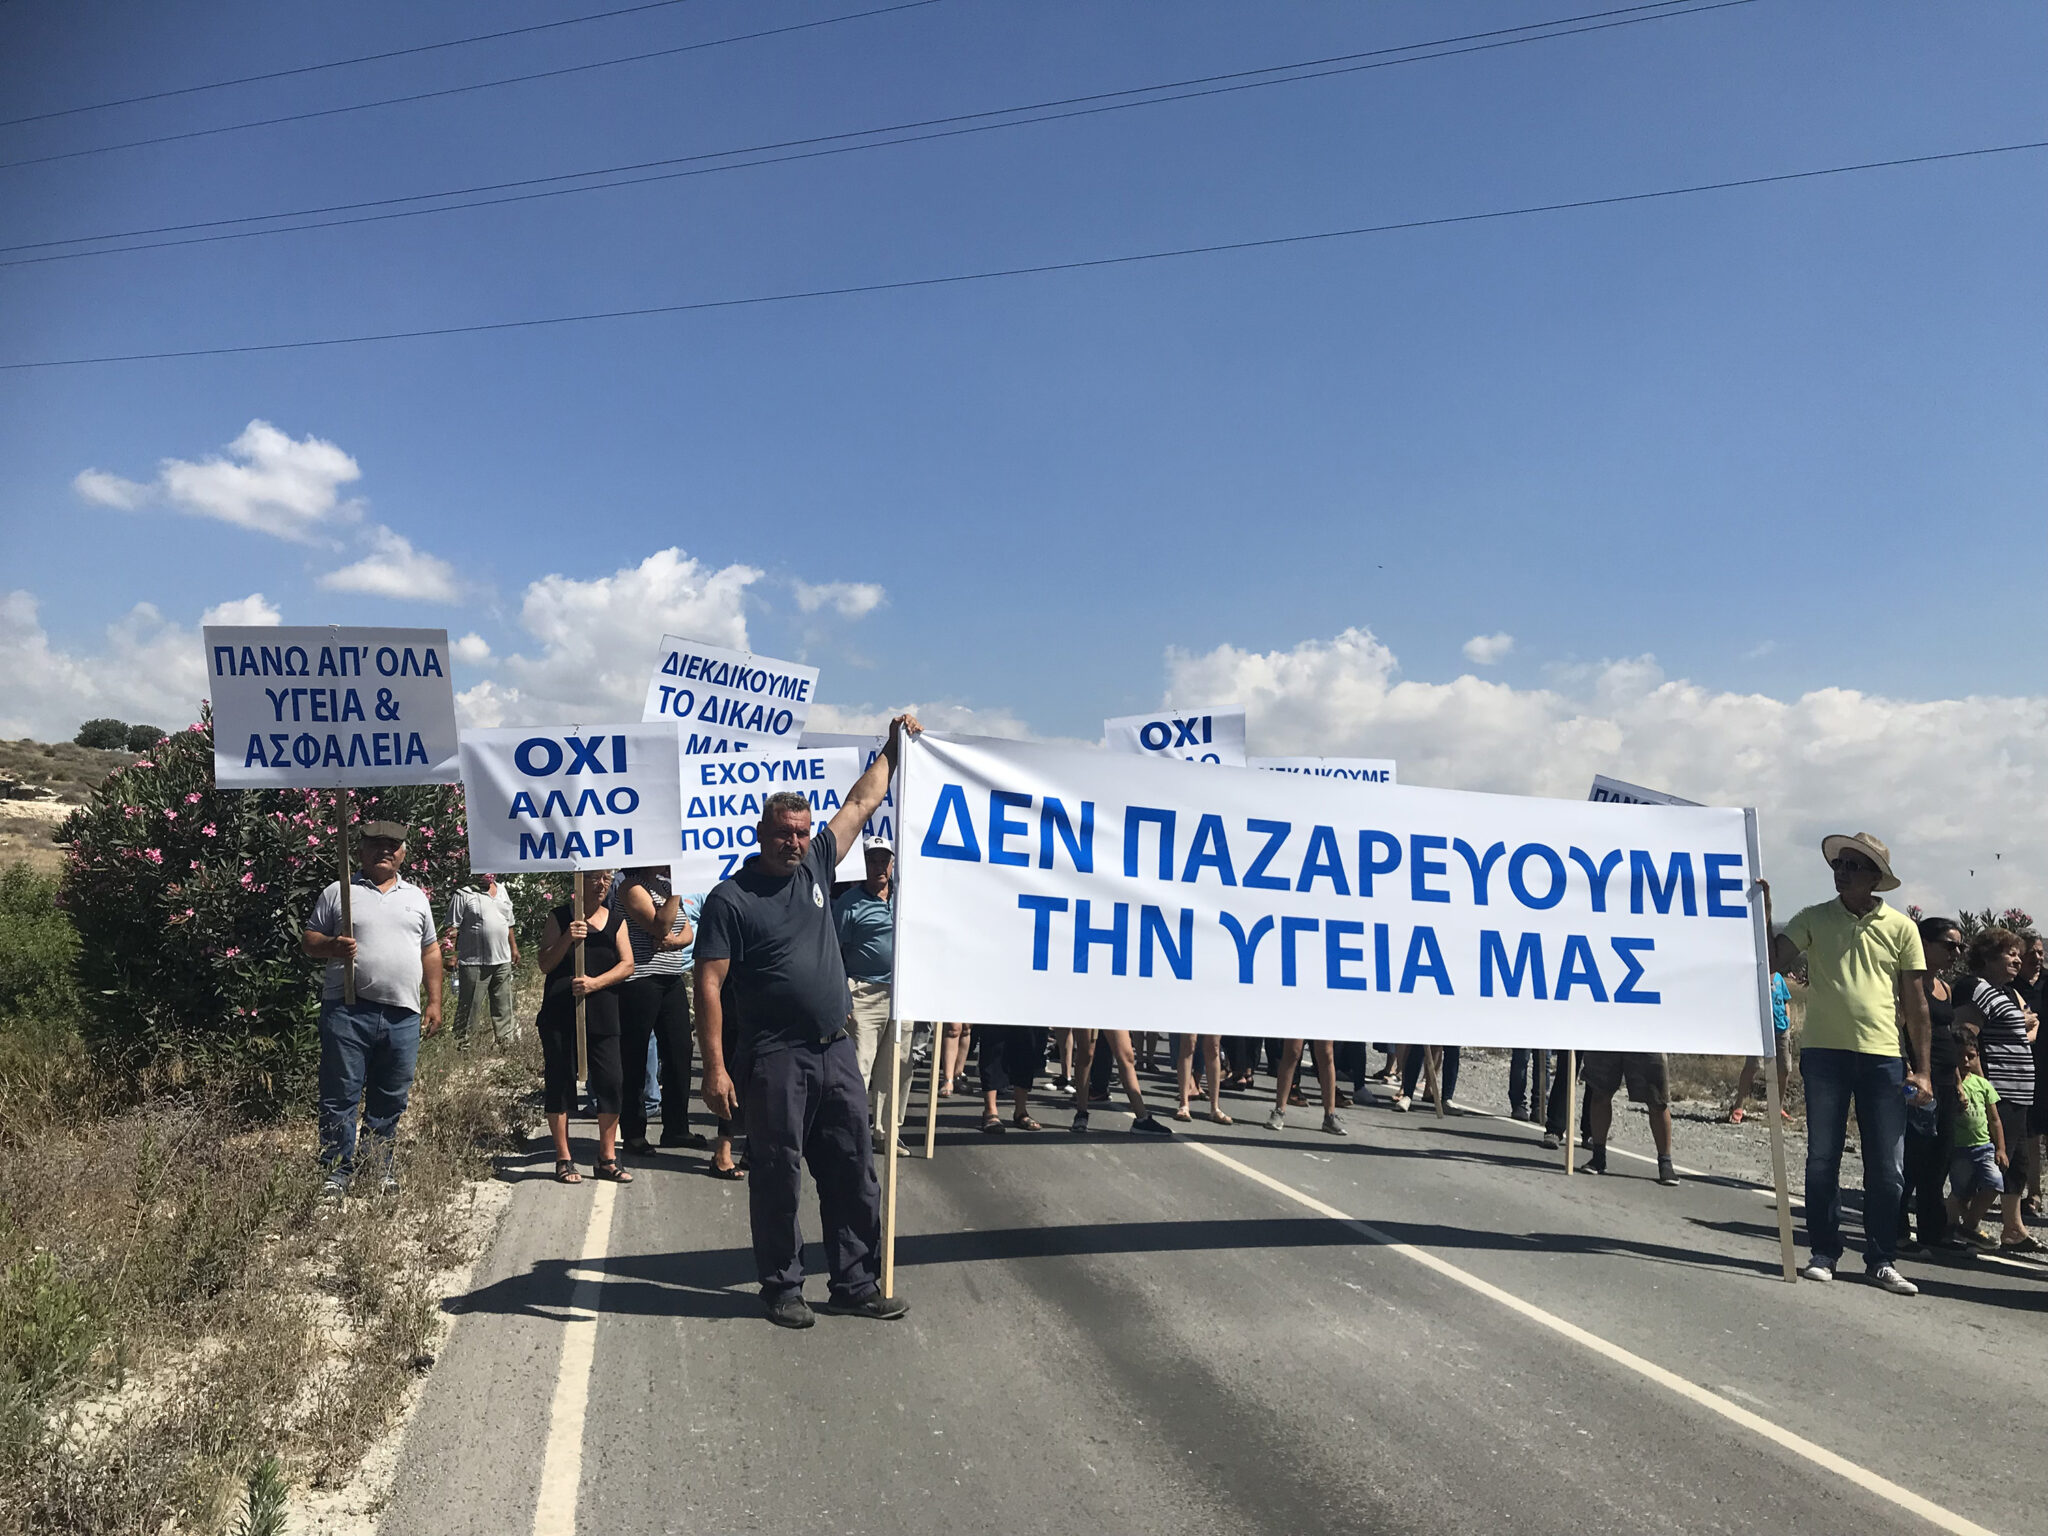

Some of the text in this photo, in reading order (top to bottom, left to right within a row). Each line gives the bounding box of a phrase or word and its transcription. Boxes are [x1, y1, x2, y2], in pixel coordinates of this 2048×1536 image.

[214, 646, 310, 677] ΠΑΝΩ
[376, 647, 444, 678] ΟΛΑ
[661, 651, 810, 703] ΔΙΕΚΔΙΚΟΥΜΕ
[265, 687, 400, 723] ΥΓΕΙΑ &
[658, 684, 794, 736] ΤΟ ΔΙΚΑΙΟ
[244, 731, 430, 769] ΑΣΦΑΛΕΙΑ
[1139, 715, 1213, 751] ΟΧΙ
[513, 735, 628, 777] ΟΧΙ
[700, 758, 826, 786] ΕΧΟΥΜΕ
[508, 786, 640, 820] ΑΛΛΟ
[686, 788, 841, 819] ΔΙΚΑΜΑ
[519, 828, 634, 861] ΜΑΡΙ
[920, 783, 1749, 919] ΔΕΝ ΠΑΖΑΡΕΥΟΥΜΕ
[1017, 893, 1662, 1005] ΤΗΝ ΥΓΕΙΑ ΜΑΣ
